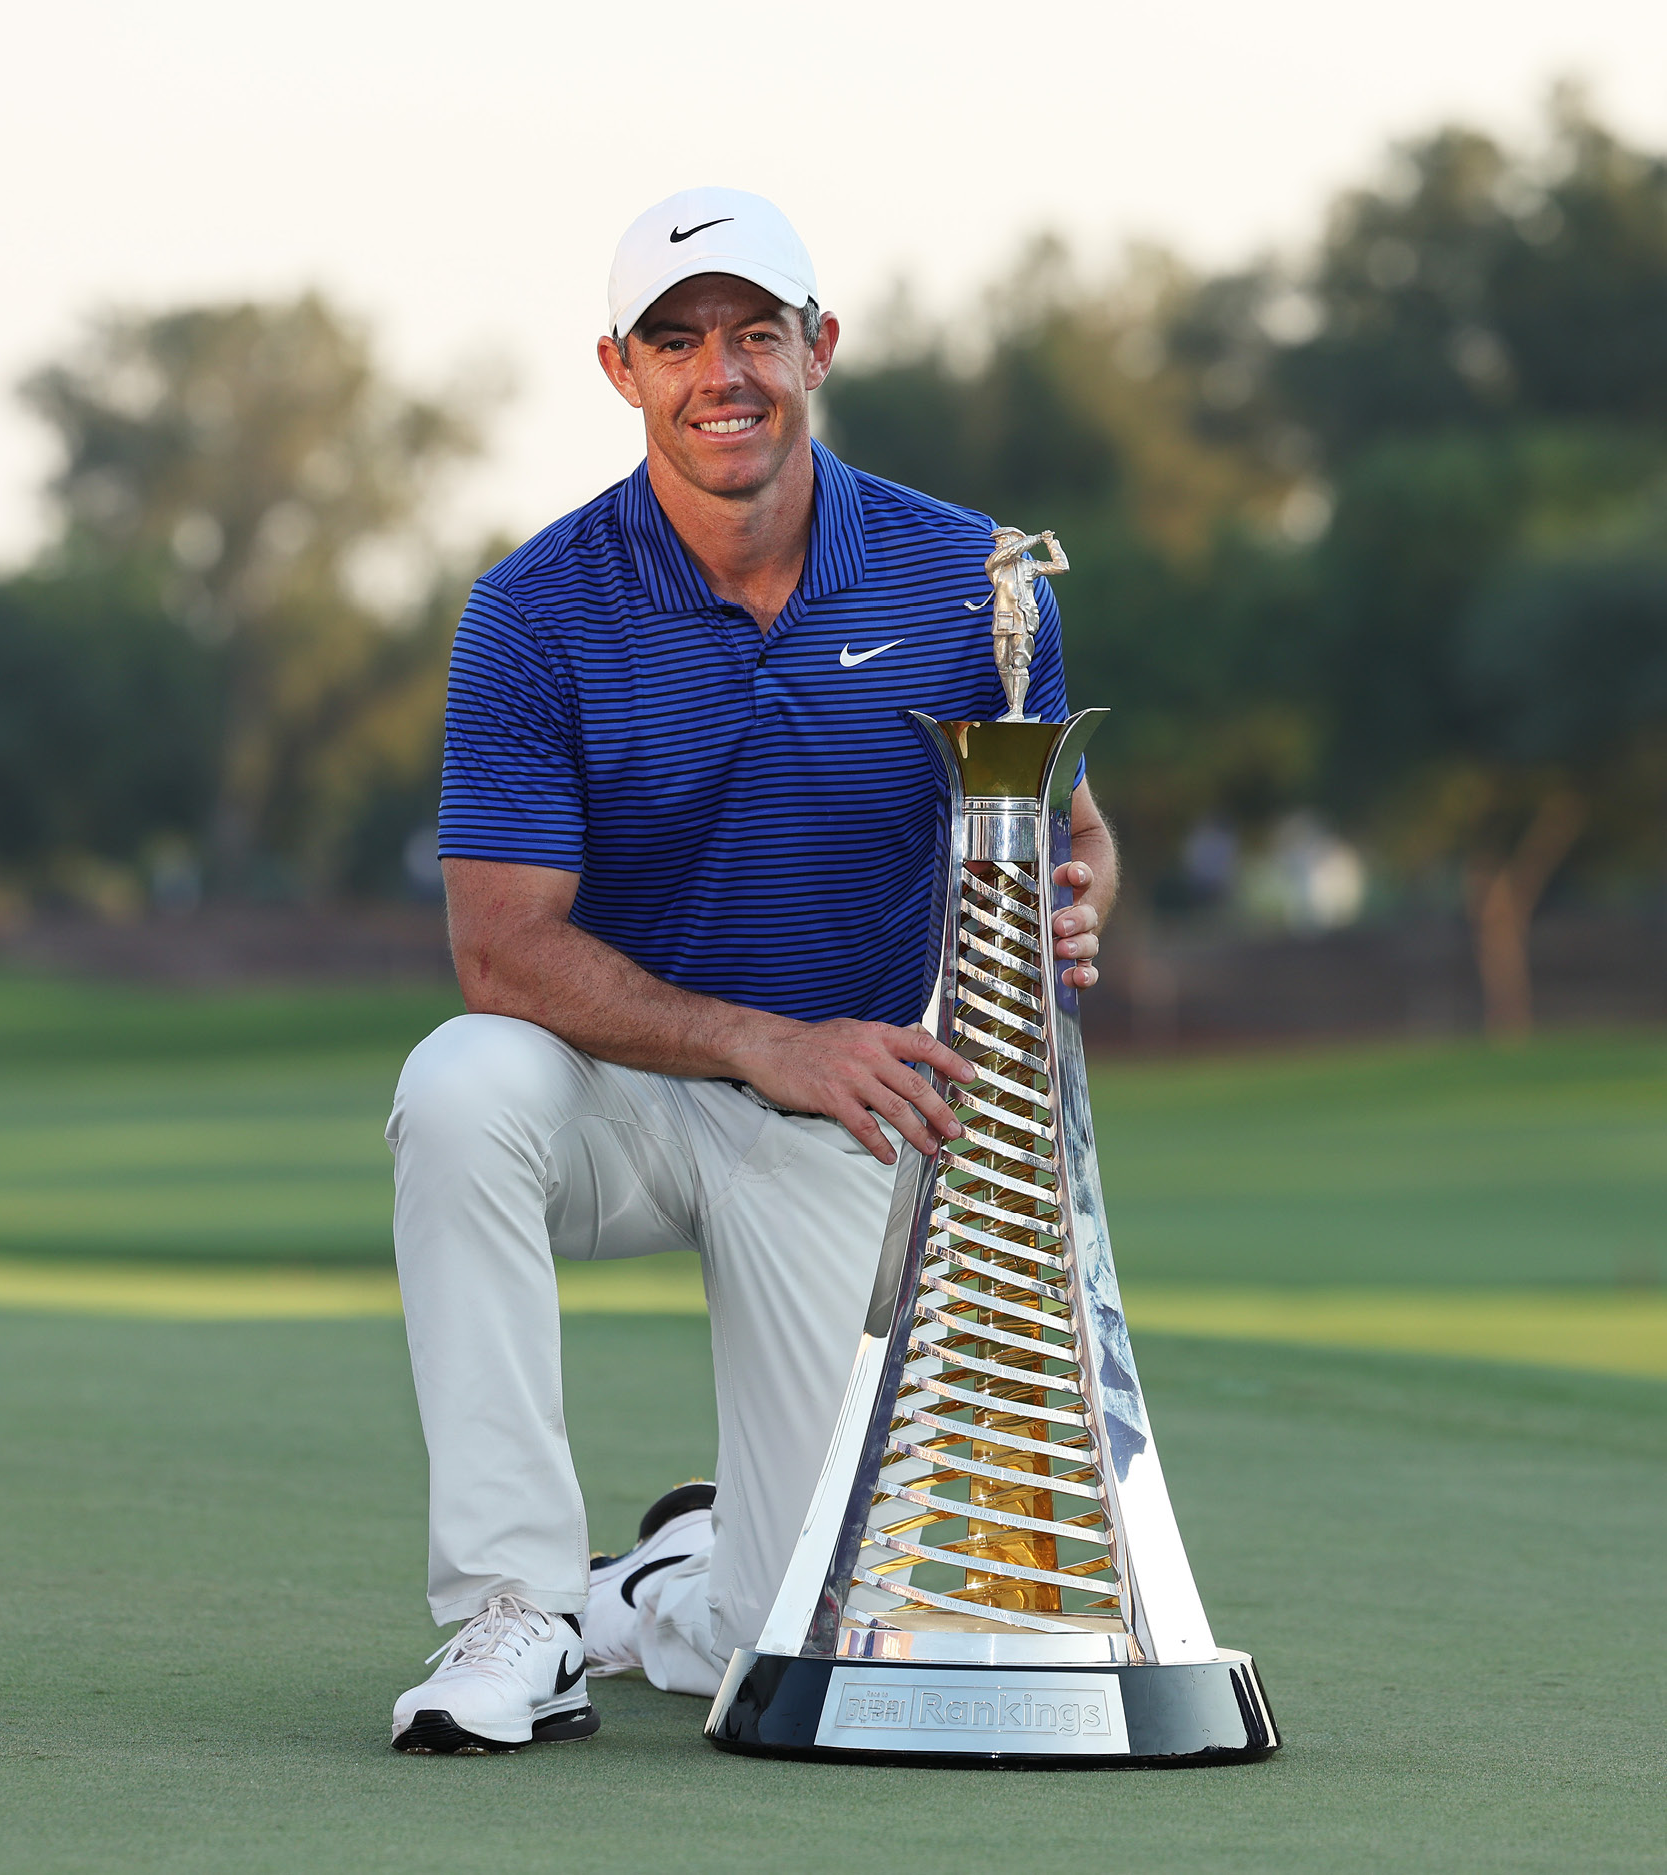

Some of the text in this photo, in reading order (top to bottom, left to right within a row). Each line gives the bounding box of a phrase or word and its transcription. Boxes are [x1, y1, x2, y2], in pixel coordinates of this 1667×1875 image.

[866, 1690, 881, 1698] Race
[845, 1698, 906, 1723] DUBAI
[918, 1692, 1101, 1737] Rankings
